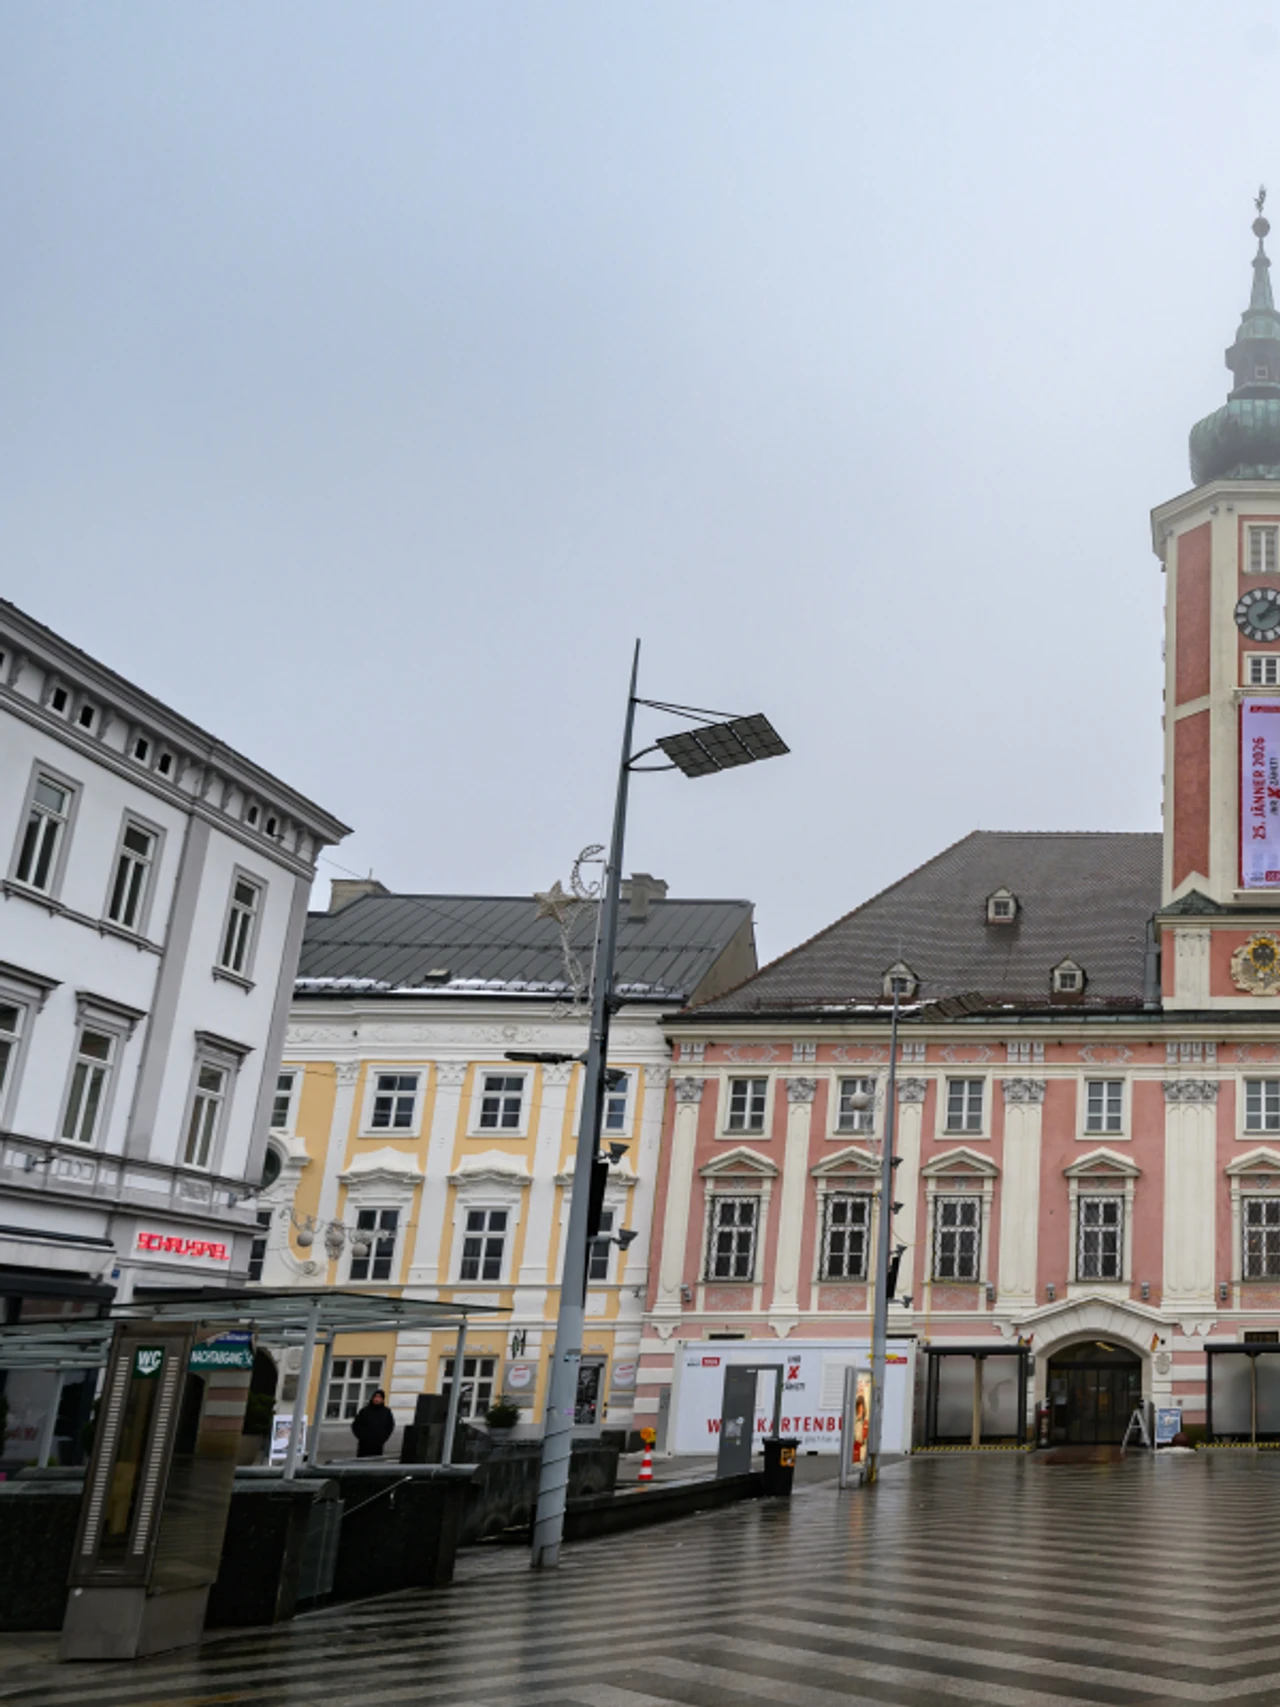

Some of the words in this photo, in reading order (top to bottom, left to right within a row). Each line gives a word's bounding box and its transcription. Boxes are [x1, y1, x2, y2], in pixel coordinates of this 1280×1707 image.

[1252, 736, 1265, 768] 2026
[1250, 770, 1266, 819] JÄNNER
[1252, 821, 1266, 840] 25.
[138, 1350, 162, 1365] WC
